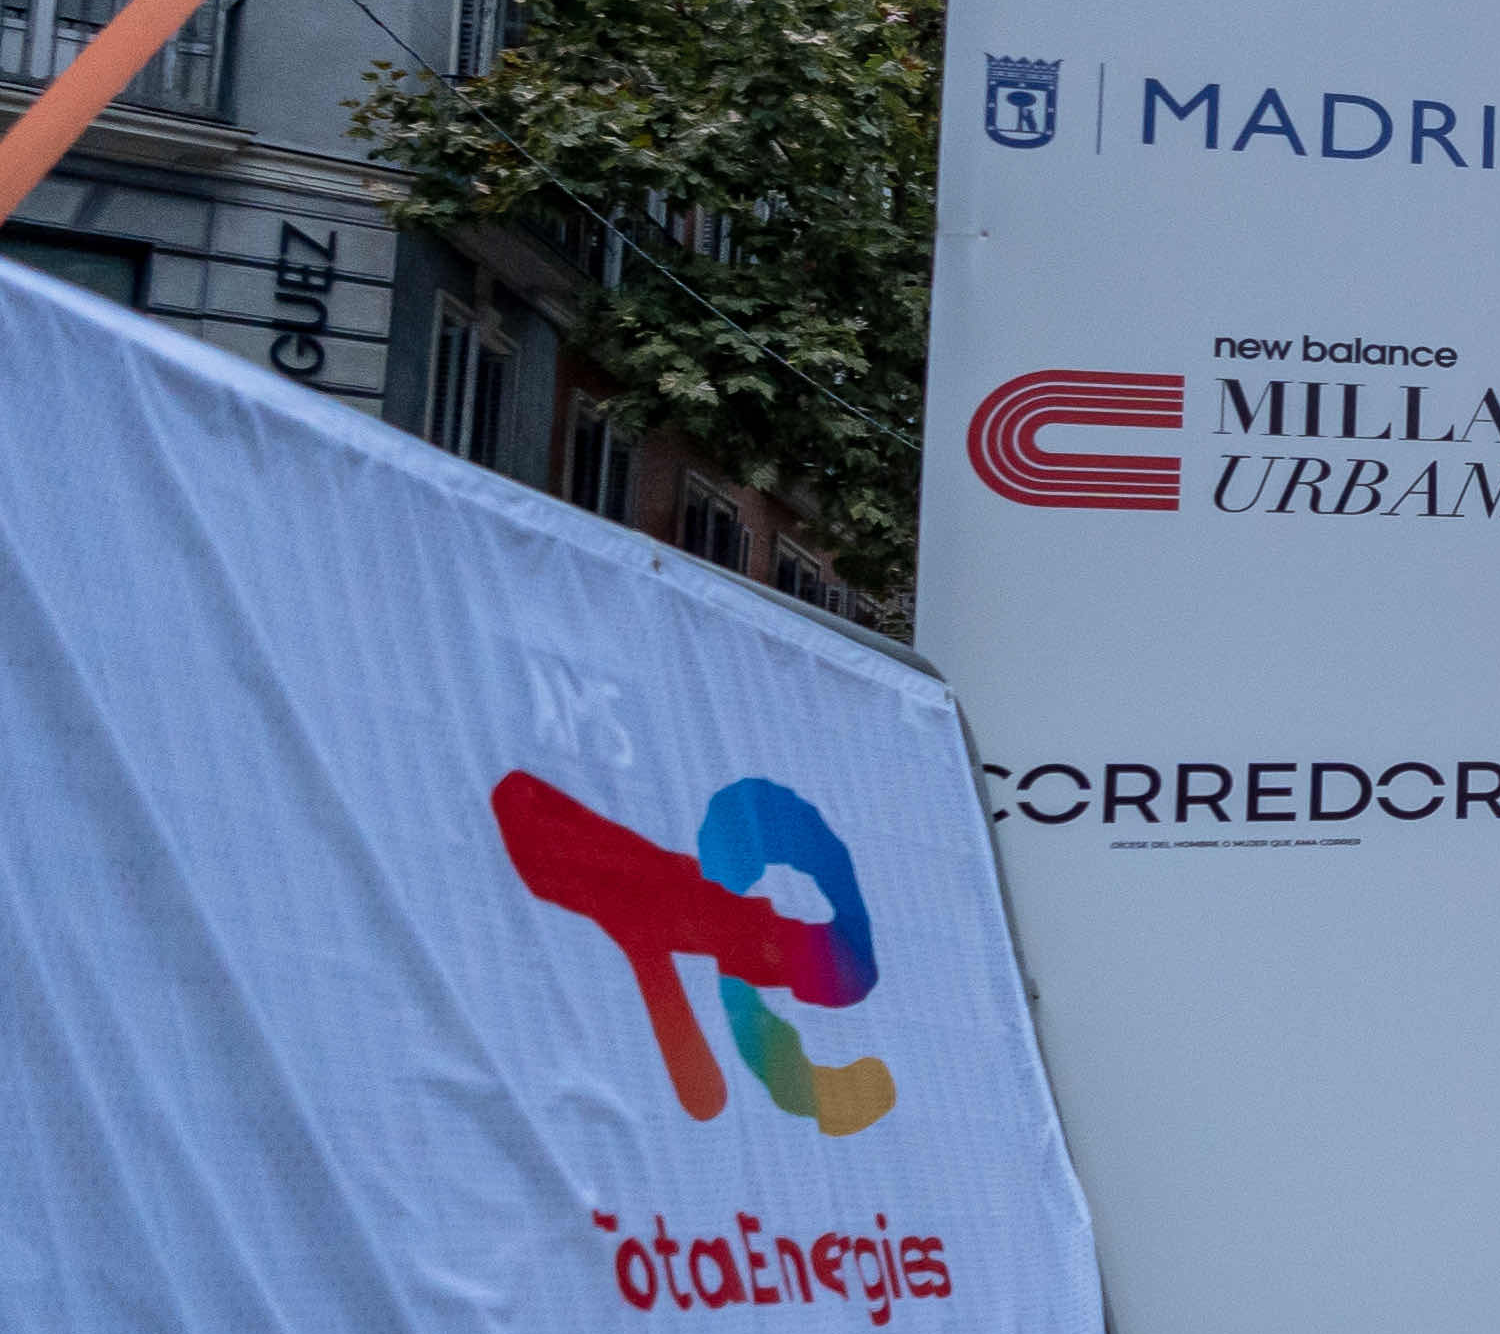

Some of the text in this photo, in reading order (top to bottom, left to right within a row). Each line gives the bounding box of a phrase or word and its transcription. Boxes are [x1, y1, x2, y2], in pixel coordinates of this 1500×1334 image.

[269, 219, 338, 378] GUEZ
[1213, 334, 1458, 370] new balance
